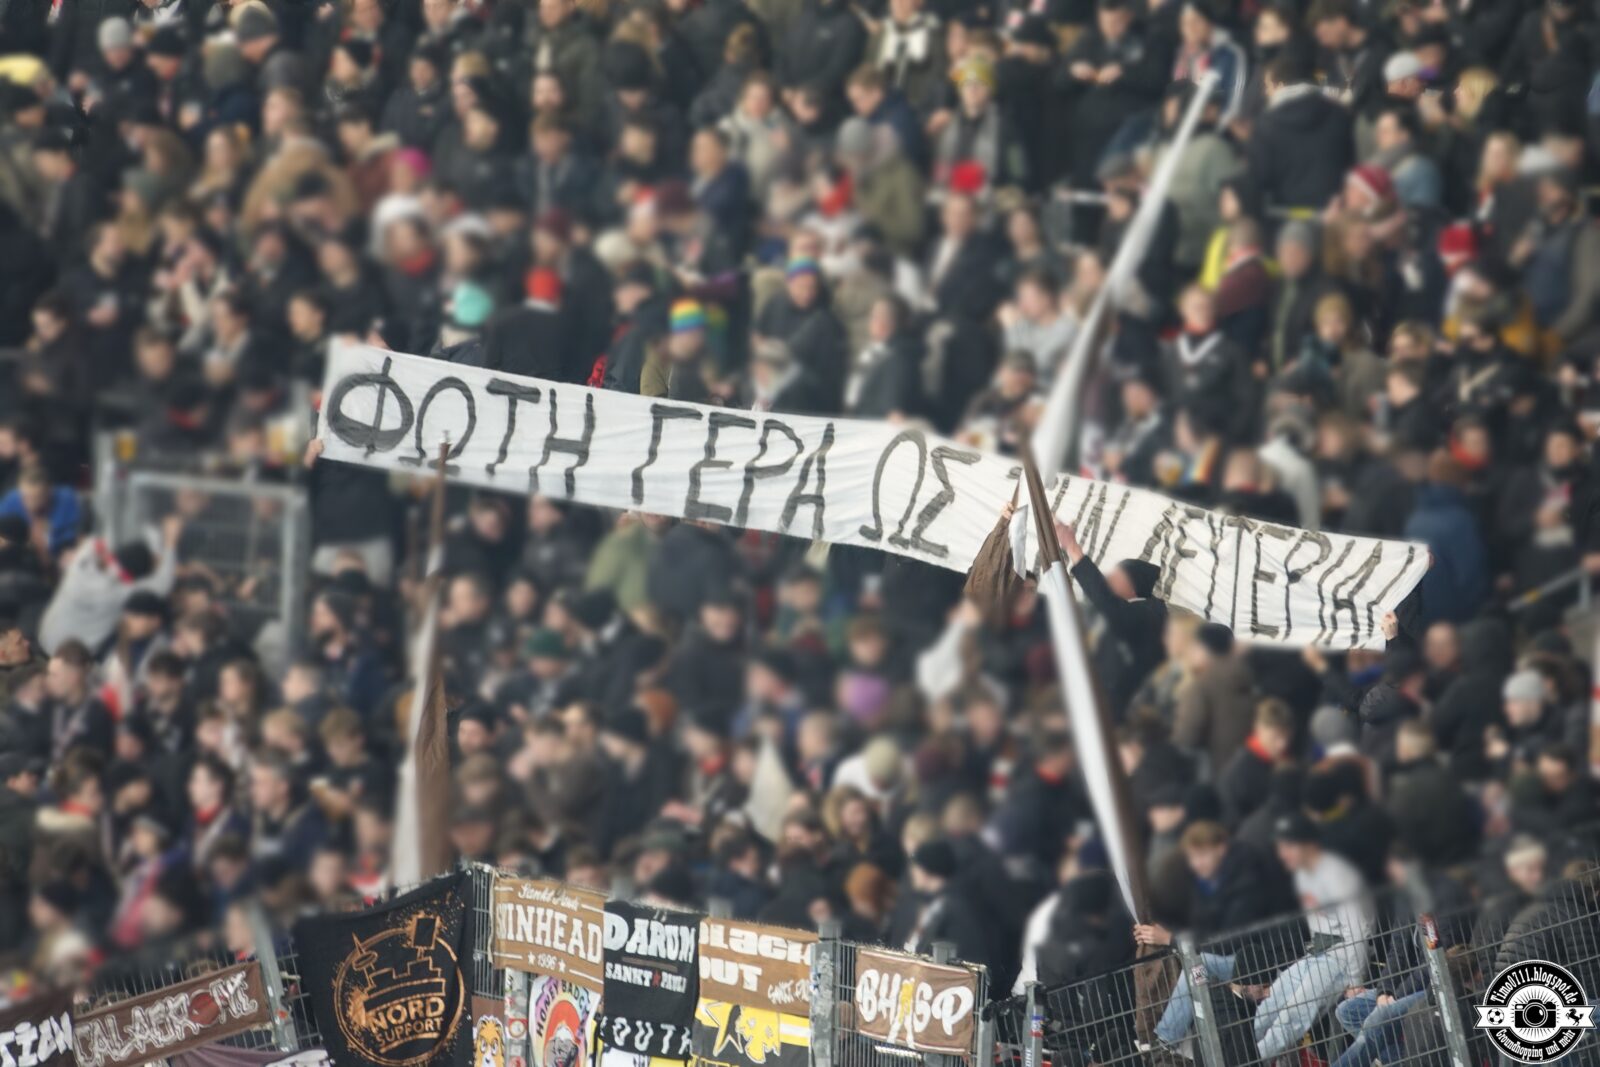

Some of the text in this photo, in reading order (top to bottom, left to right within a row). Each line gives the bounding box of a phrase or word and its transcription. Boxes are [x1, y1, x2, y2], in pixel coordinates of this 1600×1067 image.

[326, 356, 597, 499] ΦΩΤΗ
[631, 403, 835, 541] ΓΕΡΑ
[857, 427, 982, 558] ΩΣ
[605, 961, 653, 987] SANKT
[369, 996, 446, 1034] NORD
[375, 1017, 445, 1047] SUPPORT
